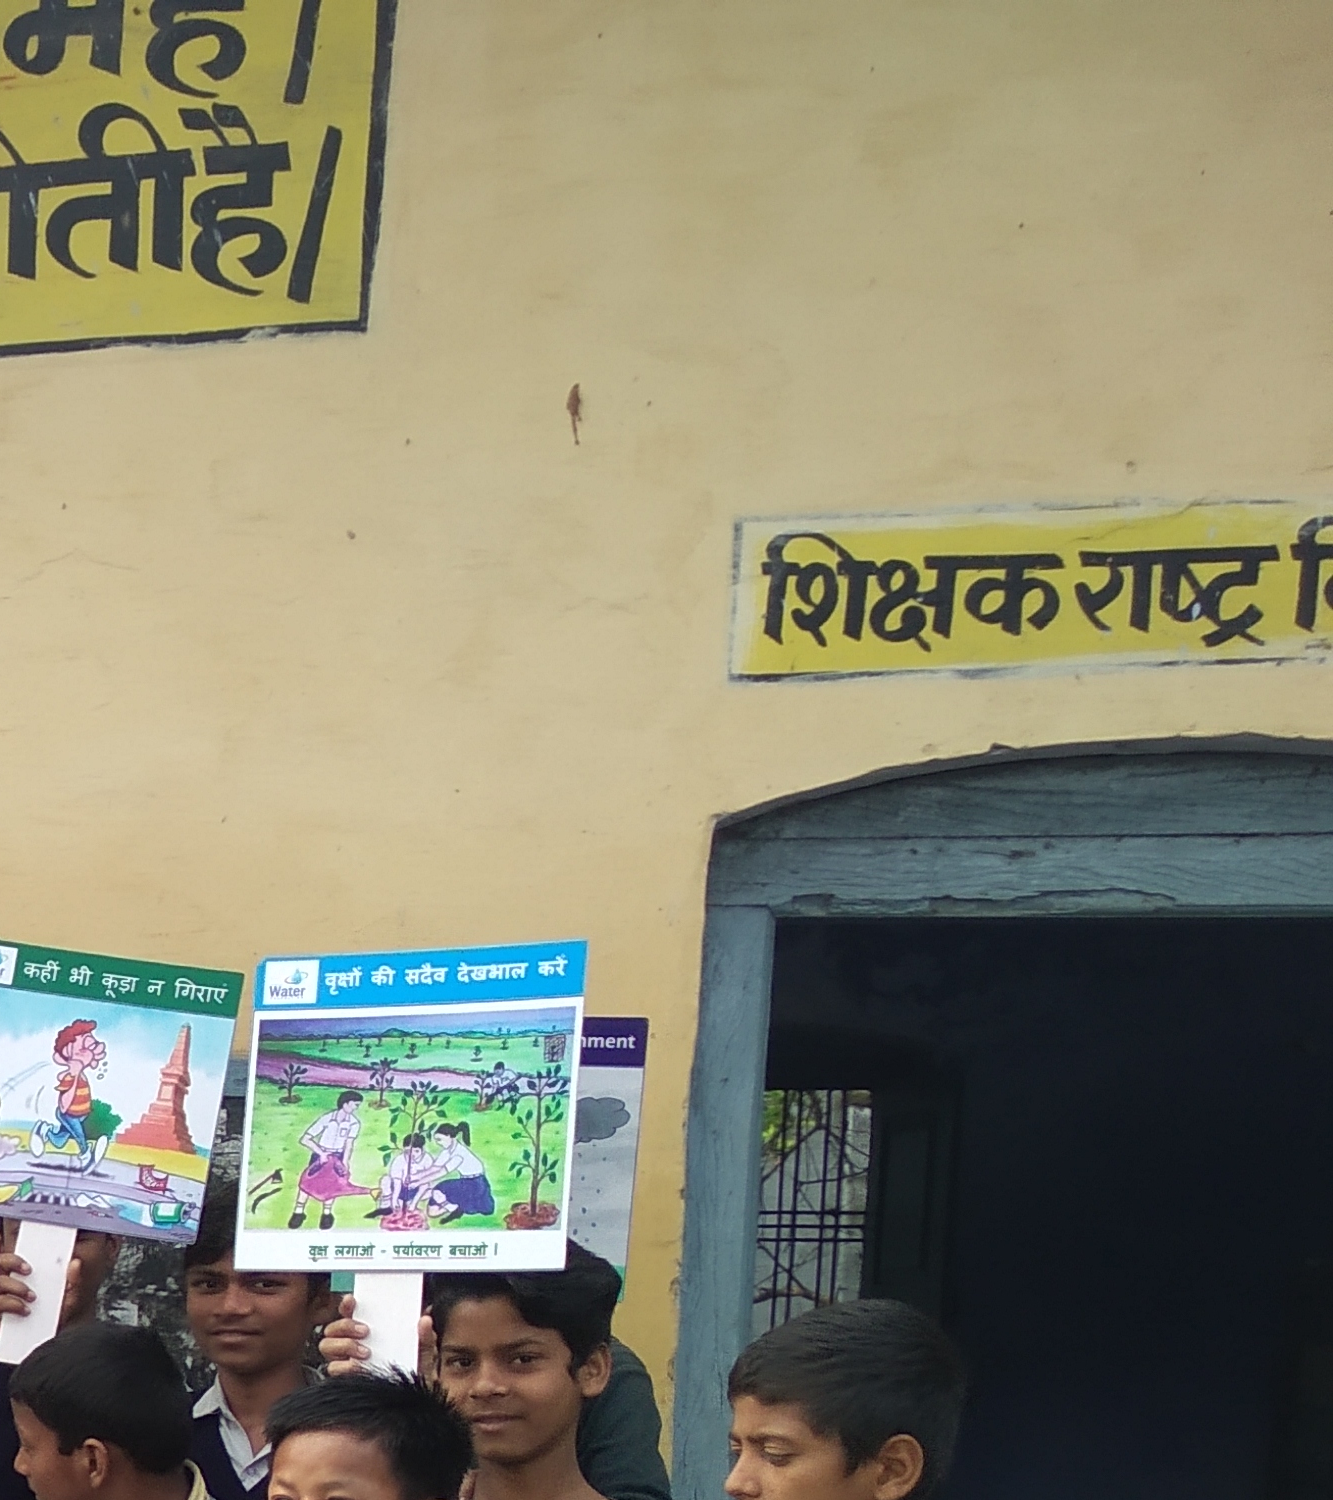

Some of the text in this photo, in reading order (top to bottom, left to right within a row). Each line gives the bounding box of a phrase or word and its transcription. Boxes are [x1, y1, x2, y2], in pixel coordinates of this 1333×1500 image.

[762, 531, 1064, 652] शिक्षक
[1074, 545, 1279, 647] राष्ट्र
[23, 960, 60, 984] कहीं
[68, 966, 93, 986] भी
[101, 972, 139, 998] कूड़ा
[147, 979, 165, 996] न
[269, 985, 306, 998] Water
[324, 953, 568, 995] वृक्षों की सदैव देखभाल करें
[334, 1241, 376, 1257] लगाओ
[392, 1240, 443, 1257] पर्यावरण
[448, 1241, 488, 1257] बचाओ
